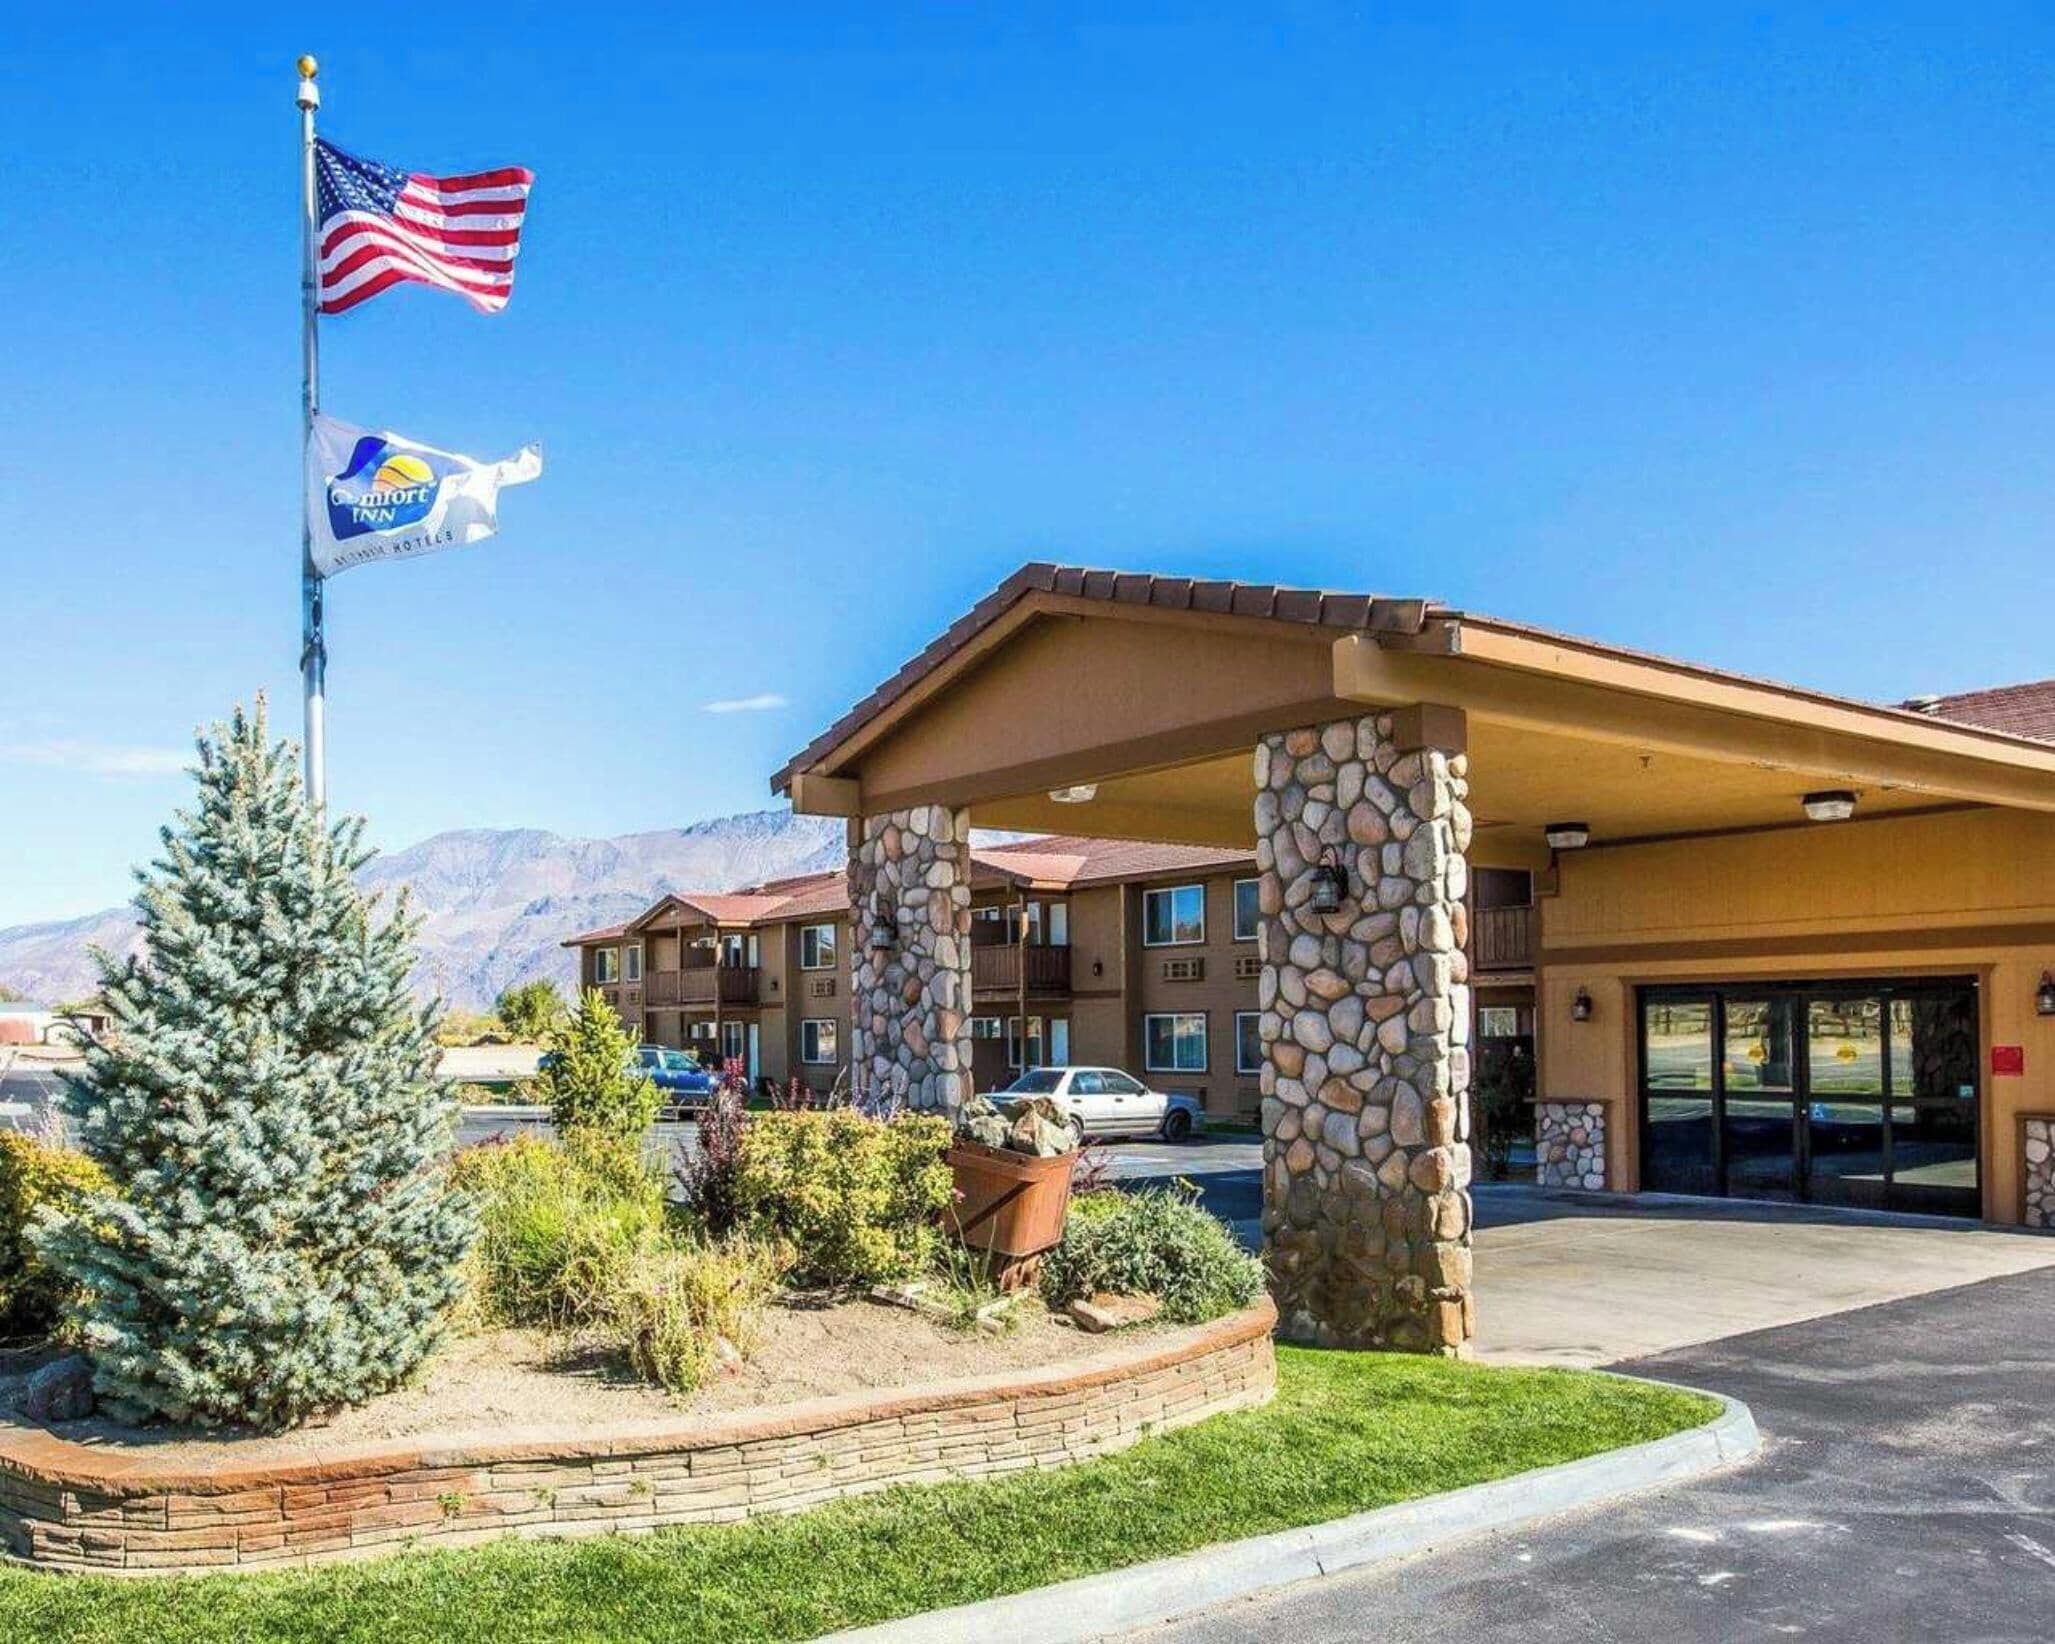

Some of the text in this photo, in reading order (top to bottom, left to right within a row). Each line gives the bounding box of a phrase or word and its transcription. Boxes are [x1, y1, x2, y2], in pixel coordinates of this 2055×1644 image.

[331, 487, 429, 506] Cmfort
[352, 507, 396, 523] INN
[393, 530, 453, 553] HOTELS
